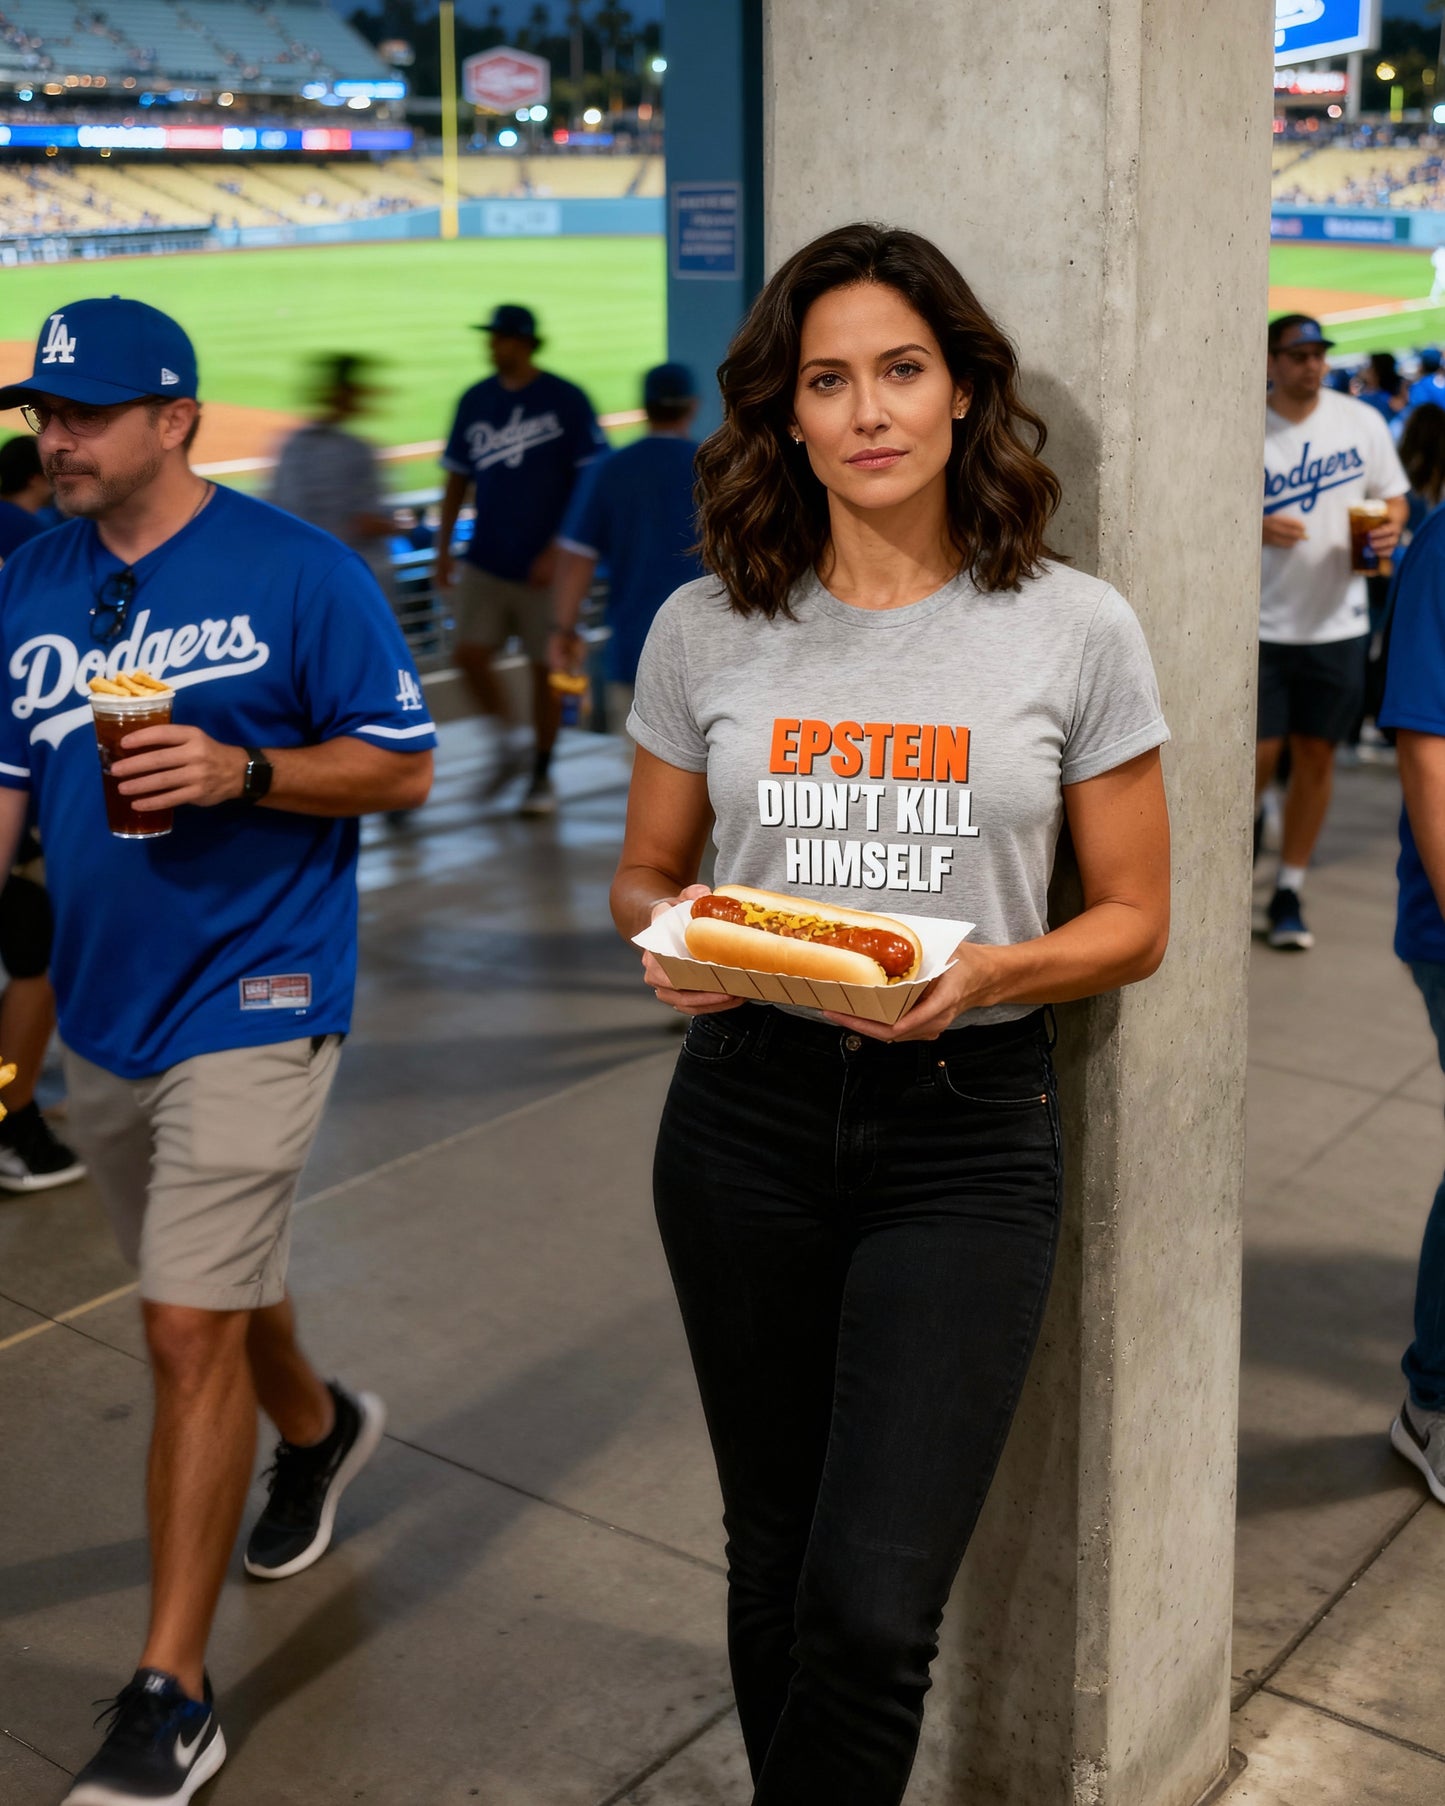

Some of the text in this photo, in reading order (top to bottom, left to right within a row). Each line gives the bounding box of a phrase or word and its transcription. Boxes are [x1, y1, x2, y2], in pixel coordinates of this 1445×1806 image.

[42, 313, 76, 364] LA
[9, 609, 270, 748] Dodgers
[395, 669, 422, 711] LA
[769, 718, 970, 783] EPSTEIN
[757, 780, 980, 837] DIDN'T KILL
[785, 838, 954, 893] HIMSELF
